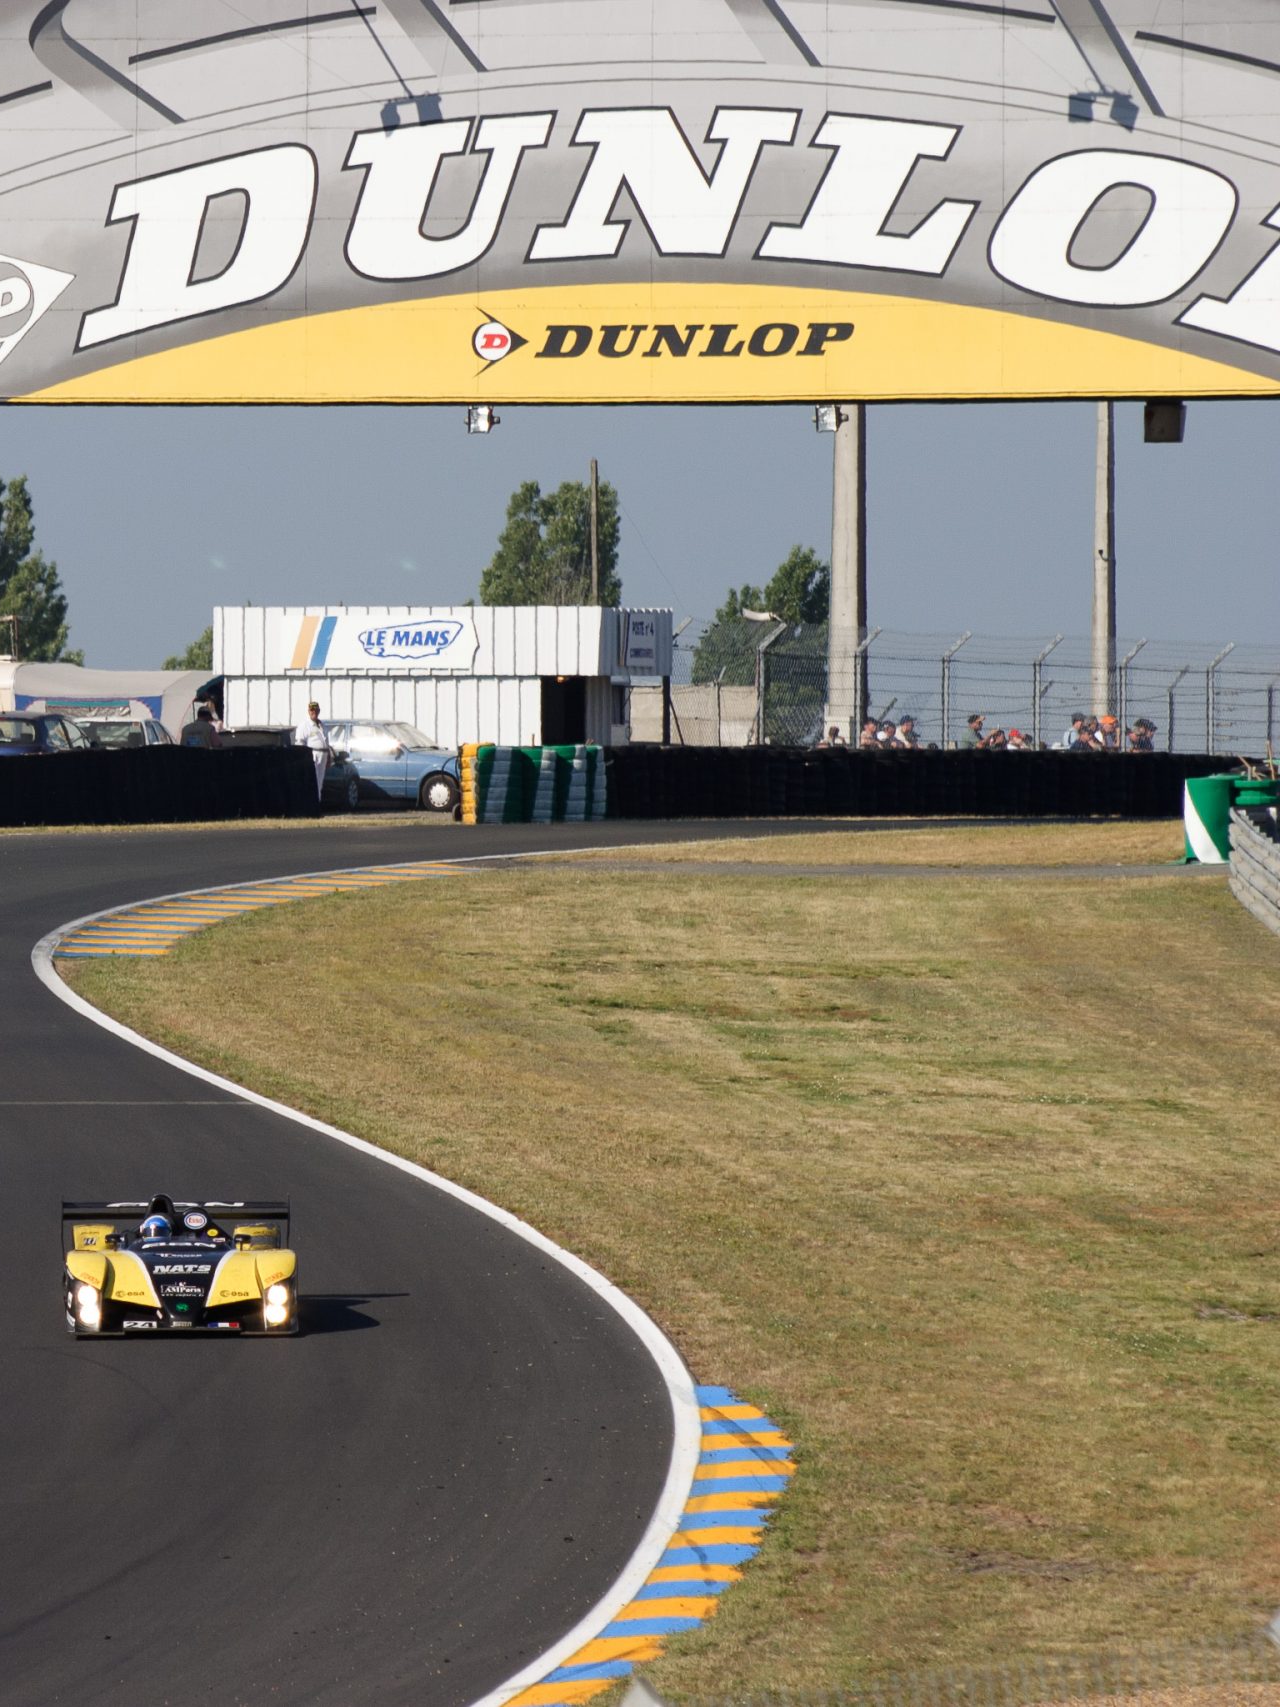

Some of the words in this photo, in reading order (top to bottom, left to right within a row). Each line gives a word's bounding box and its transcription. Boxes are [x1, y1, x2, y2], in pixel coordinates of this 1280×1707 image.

[535, 323, 855, 359] DUNLOP
[366, 630, 387, 647] LE
[391, 630, 450, 647] MANS
[153, 1264, 211, 1275] NATS
